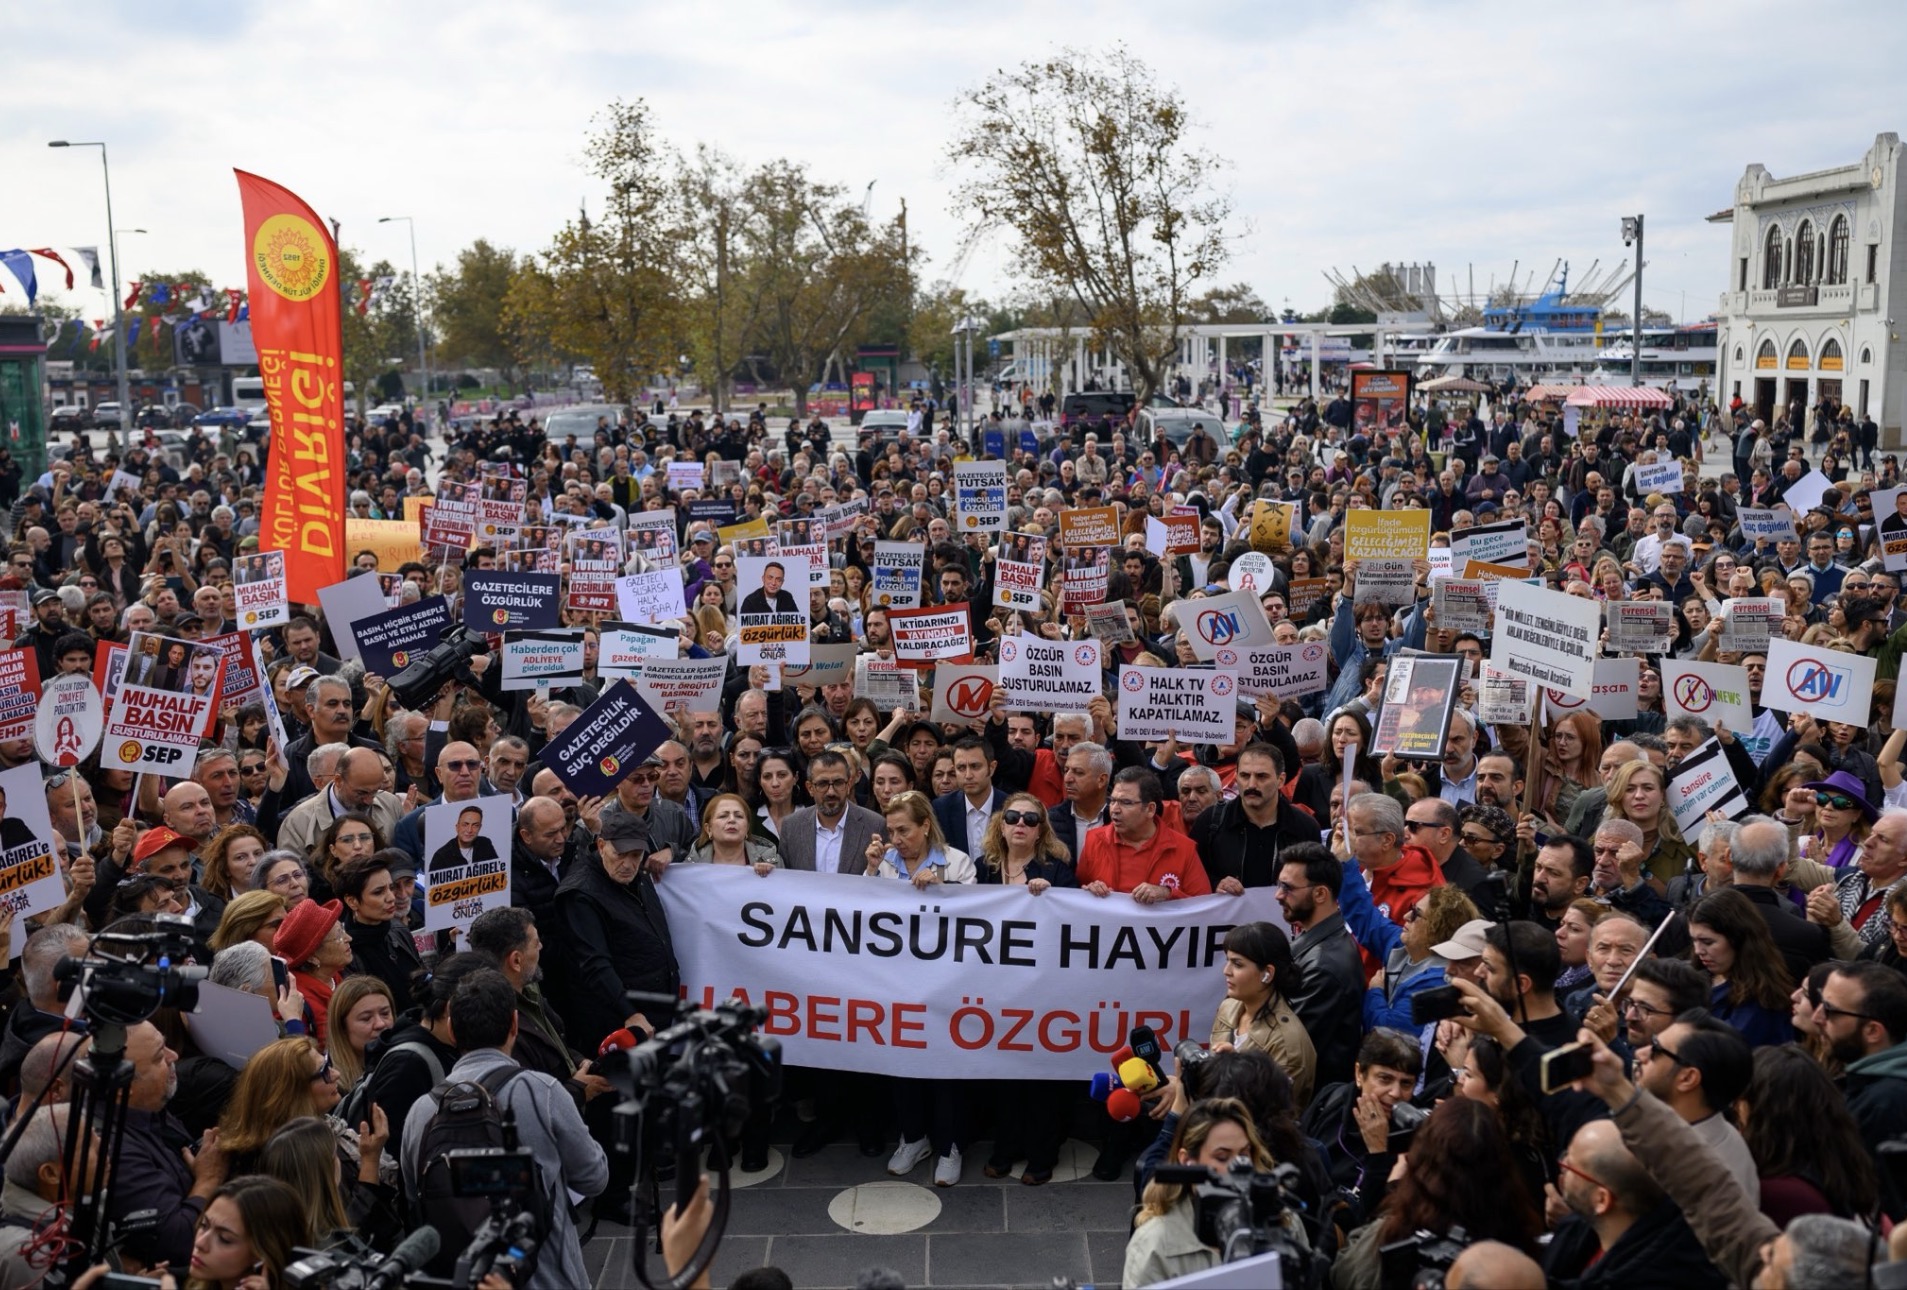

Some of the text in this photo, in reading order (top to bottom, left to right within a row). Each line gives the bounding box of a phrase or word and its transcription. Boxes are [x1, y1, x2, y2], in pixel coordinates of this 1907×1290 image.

[959, 478, 1004, 487] TUTSAK
[1640, 479, 1652, 487] suç
[482, 501, 524, 512] MUHALİF
[485, 510, 519, 521] BASIN
[979, 517, 1001, 525] SEP
[496, 527, 516, 536] SEP
[1470, 534, 1505, 547] Bu gece
[782, 546, 826, 556] MUHALİF
[1349, 546, 1425, 558] KAZANACAĞIZ
[1453, 538, 1525, 557] hangi gazetecinin evi
[574, 560, 615, 571] TUTUKLU
[876, 557, 921, 567] TUTSAK
[998, 562, 1041, 577] MUHALİF
[1067, 565, 1107, 580] TUTUKLU
[809, 573, 823, 581] EP
[1001, 572, 1037, 587] BASIN
[237, 579, 283, 596] MUHALİF
[472, 581, 553, 595] GAZETECİLERE
[571, 581, 616, 592] ÖZGÜRLÜK!
[1446, 584, 1480, 595] evrensel
[242, 589, 280, 605] BASIN
[481, 593, 543, 608] ÖZGÜRLÜK
[637, 595, 659, 605] HALK
[892, 596, 913, 604] SEP
[1013, 593, 1033, 604] SEP
[1621, 605, 1657, 615] evrensel
[1733, 602, 1770, 612] evrensel
[258, 608, 280, 620] SEP
[741, 612, 806, 626] MURAT AĞIREL'e
[357, 605, 446, 638] BASIN, HİÇBİR SEBEPLE
[899, 616, 960, 630] İKTİDARINIZI
[1208, 612, 1241, 640] AW
[364, 615, 446, 646] BASKI VE ETKİ ALTINA
[742, 625, 805, 643] özgürlük!
[905, 628, 956, 639] YAYINDAN
[387, 631, 428, 648] ALINAMAZ
[620, 633, 657, 645] Papağan
[896, 637, 968, 650] KALDIRACAĞIZ!
[510, 644, 578, 655] Haberden çok
[629, 645, 647, 654] değil
[760, 651, 786, 660] ONLAR
[1026, 646, 1065, 662] ÖZGÜR
[523, 654, 563, 664] ADLİYEYE
[1249, 651, 1292, 664] ÖZGÜR
[522, 663, 565, 673] gider olduk
[646, 665, 696, 674] GAZETECİLER
[815, 661, 844, 670] Welat
[1029, 663, 1063, 677] BASIN
[1253, 665, 1289, 676] BASIN
[1508, 657, 1572, 688] Mustafa Kemal Atatürk
[649, 680, 718, 690] UMUT, ÖRGÜTLÜ
[1002, 677, 1096, 694] SUSTURULAMAZ.
[1150, 677, 1205, 690] HALK TV
[1238, 671, 1320, 688] STURULAMAZ.
[1799, 668, 1843, 698] AW
[661, 690, 703, 698] BASINDA!
[1592, 684, 1629, 695] aşam
[121, 689, 207, 714] MUHALİF
[1149, 693, 1204, 706] HALKTIR
[1703, 688, 1742, 706] JNNEWS
[124, 706, 195, 733] BASIN
[1129, 708, 1223, 724] KAPATILAMAZ.
[111, 724, 199, 745] SUSTURULAMAZ!
[558, 695, 631, 762] GAZETECİLİK
[1182, 728, 1203, 738] İstanbul
[1205, 731, 1228, 740] Şubeleri
[566, 706, 643, 777] SUÇ DEĞİLDİR
[142, 746, 183, 764] SEP
[1680, 771, 1713, 797] Sansüre
[1674, 772, 1732, 817] alerjim var canım!
[0, 842, 50, 870] AĞIREL'e
[430, 860, 506, 886] MURAT AĞIREL'e
[432, 873, 505, 903] özgürlük!
[452, 905, 483, 919] ONLAR
[737, 901, 1037, 968] SANSÜRE
[949, 996, 1210, 1053] ÖZGÜRL
